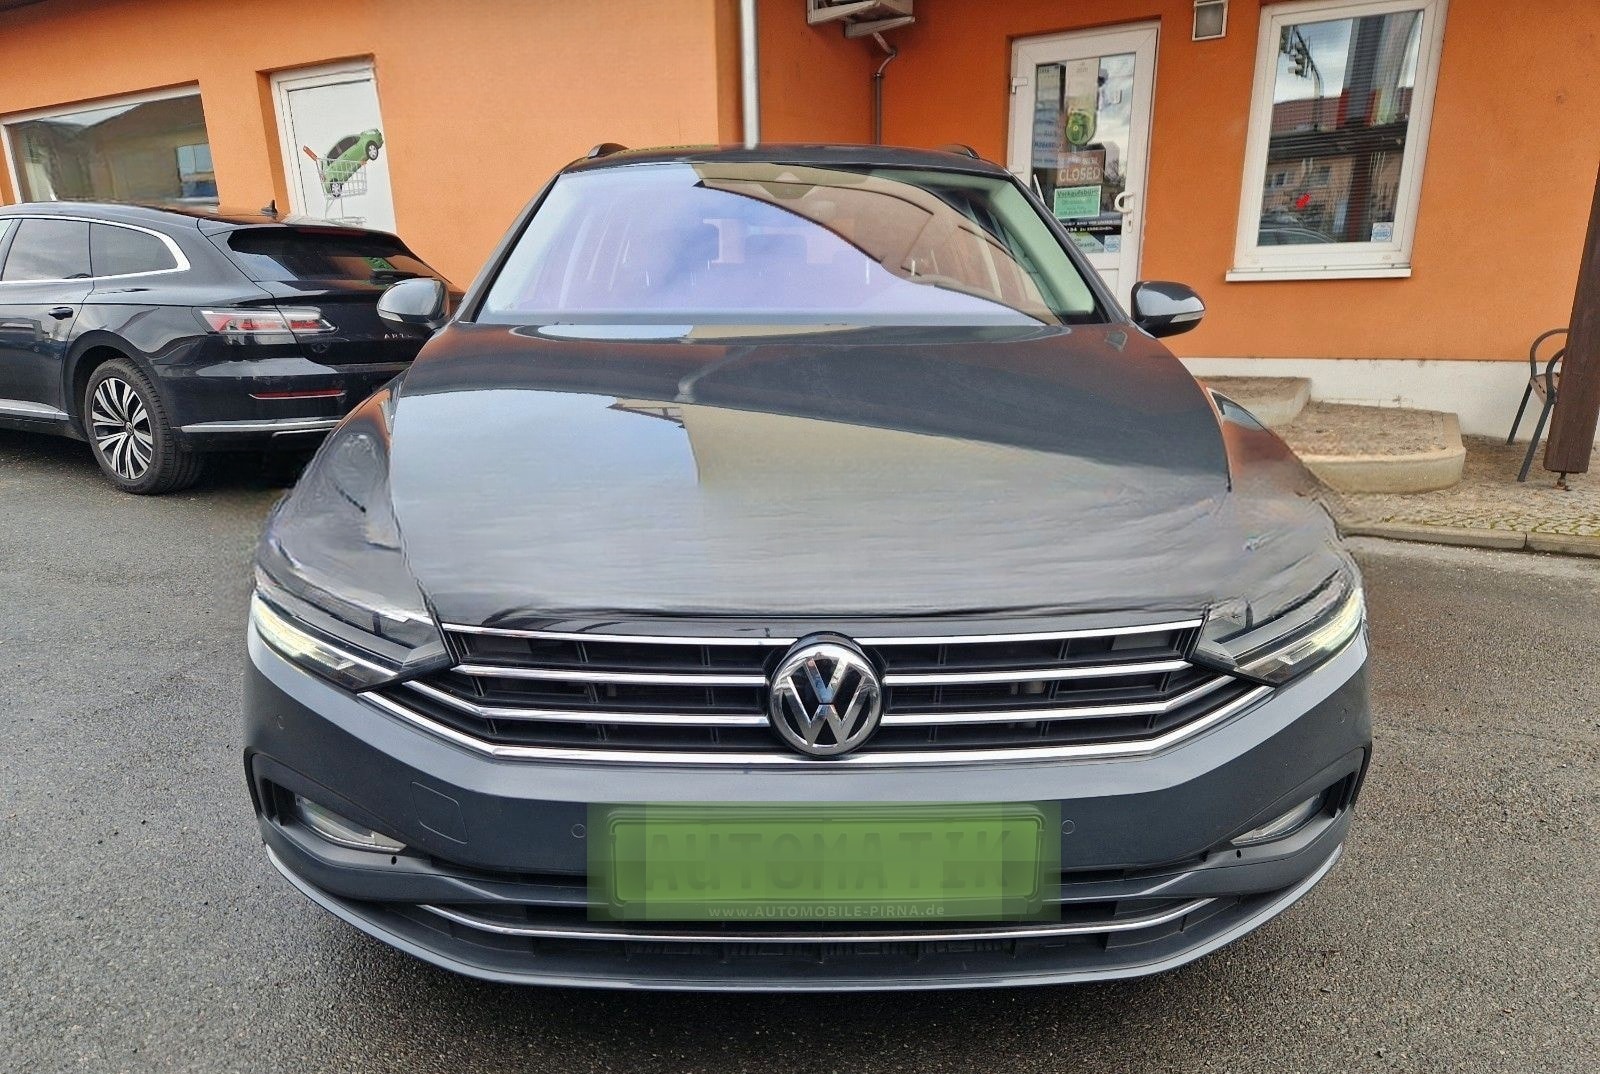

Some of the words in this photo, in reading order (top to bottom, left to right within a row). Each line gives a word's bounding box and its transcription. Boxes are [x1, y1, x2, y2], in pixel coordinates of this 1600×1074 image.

[1060, 167, 1101, 181] CLOSED
[775, 647, 876, 752] VW
[646, 831, 1011, 891] AUTOMATIK
[708, 904, 945, 917] www.AUTOMOBILE-PIRNA.de
